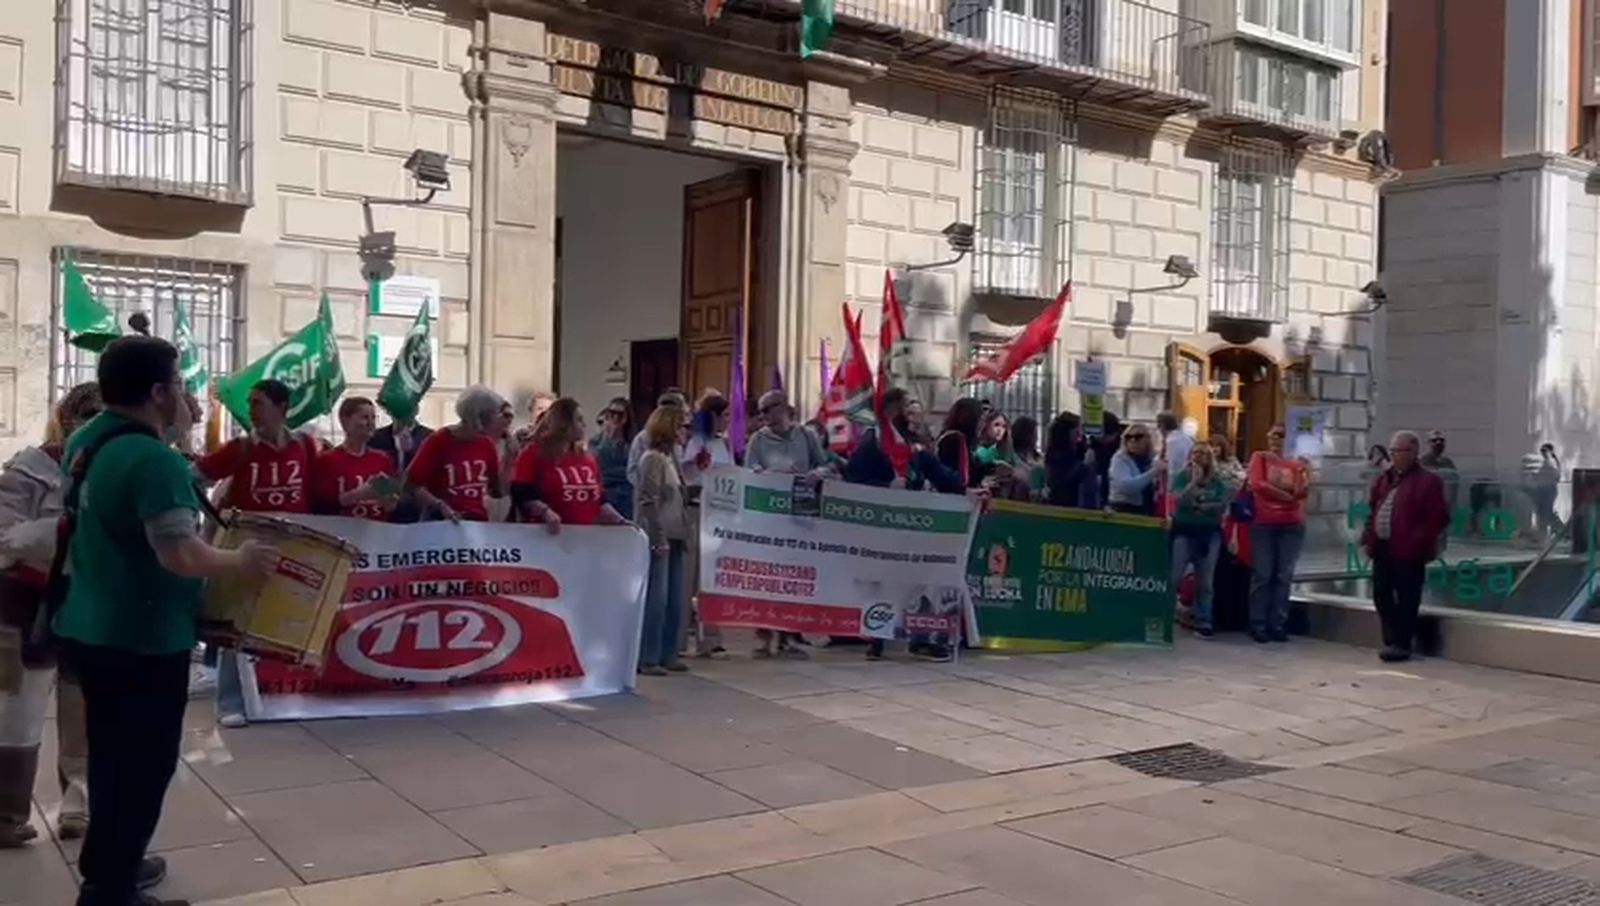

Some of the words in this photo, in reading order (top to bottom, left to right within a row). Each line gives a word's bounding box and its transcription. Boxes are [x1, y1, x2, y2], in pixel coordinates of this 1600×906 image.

[250, 460, 303, 488] 112
[445, 460, 489, 486] 112
[555, 466, 597, 484] 112
[713, 476, 737, 496] 112
[825, 503, 875, 521] EMPLEO
[377, 548, 522, 568] EMERGENCIAS
[1041, 543, 1065, 567] 112
[352, 585, 400, 602] SON
[406, 582, 439, 598] UN
[1038, 570, 1065, 586] POR
[1083, 574, 1168, 593] INTEGRACIÓN
[1036, 584, 1053, 611] EN
[1055, 586, 1087, 613] EMA
[368, 609, 494, 656] 112
